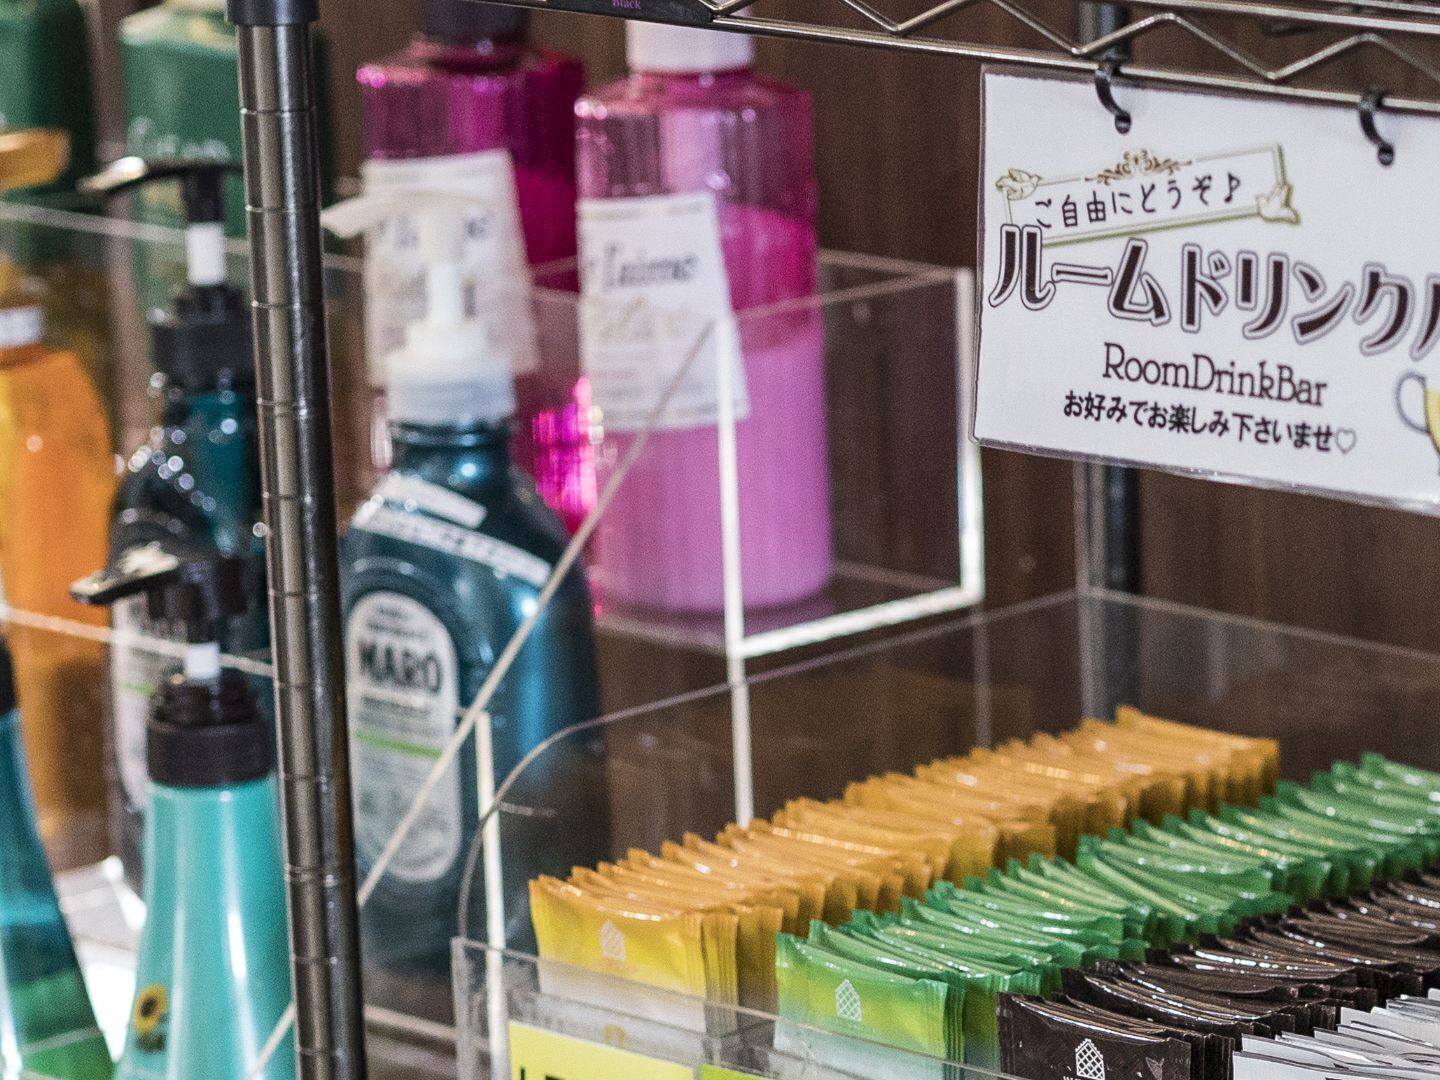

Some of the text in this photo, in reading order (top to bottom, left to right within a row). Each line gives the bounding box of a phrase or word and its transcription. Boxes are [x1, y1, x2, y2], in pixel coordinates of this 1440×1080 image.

[1102, 343, 1328, 407] RoomDrinkBar
[1062, 390, 1334, 453] お好みでお楽しみ下さいませ
